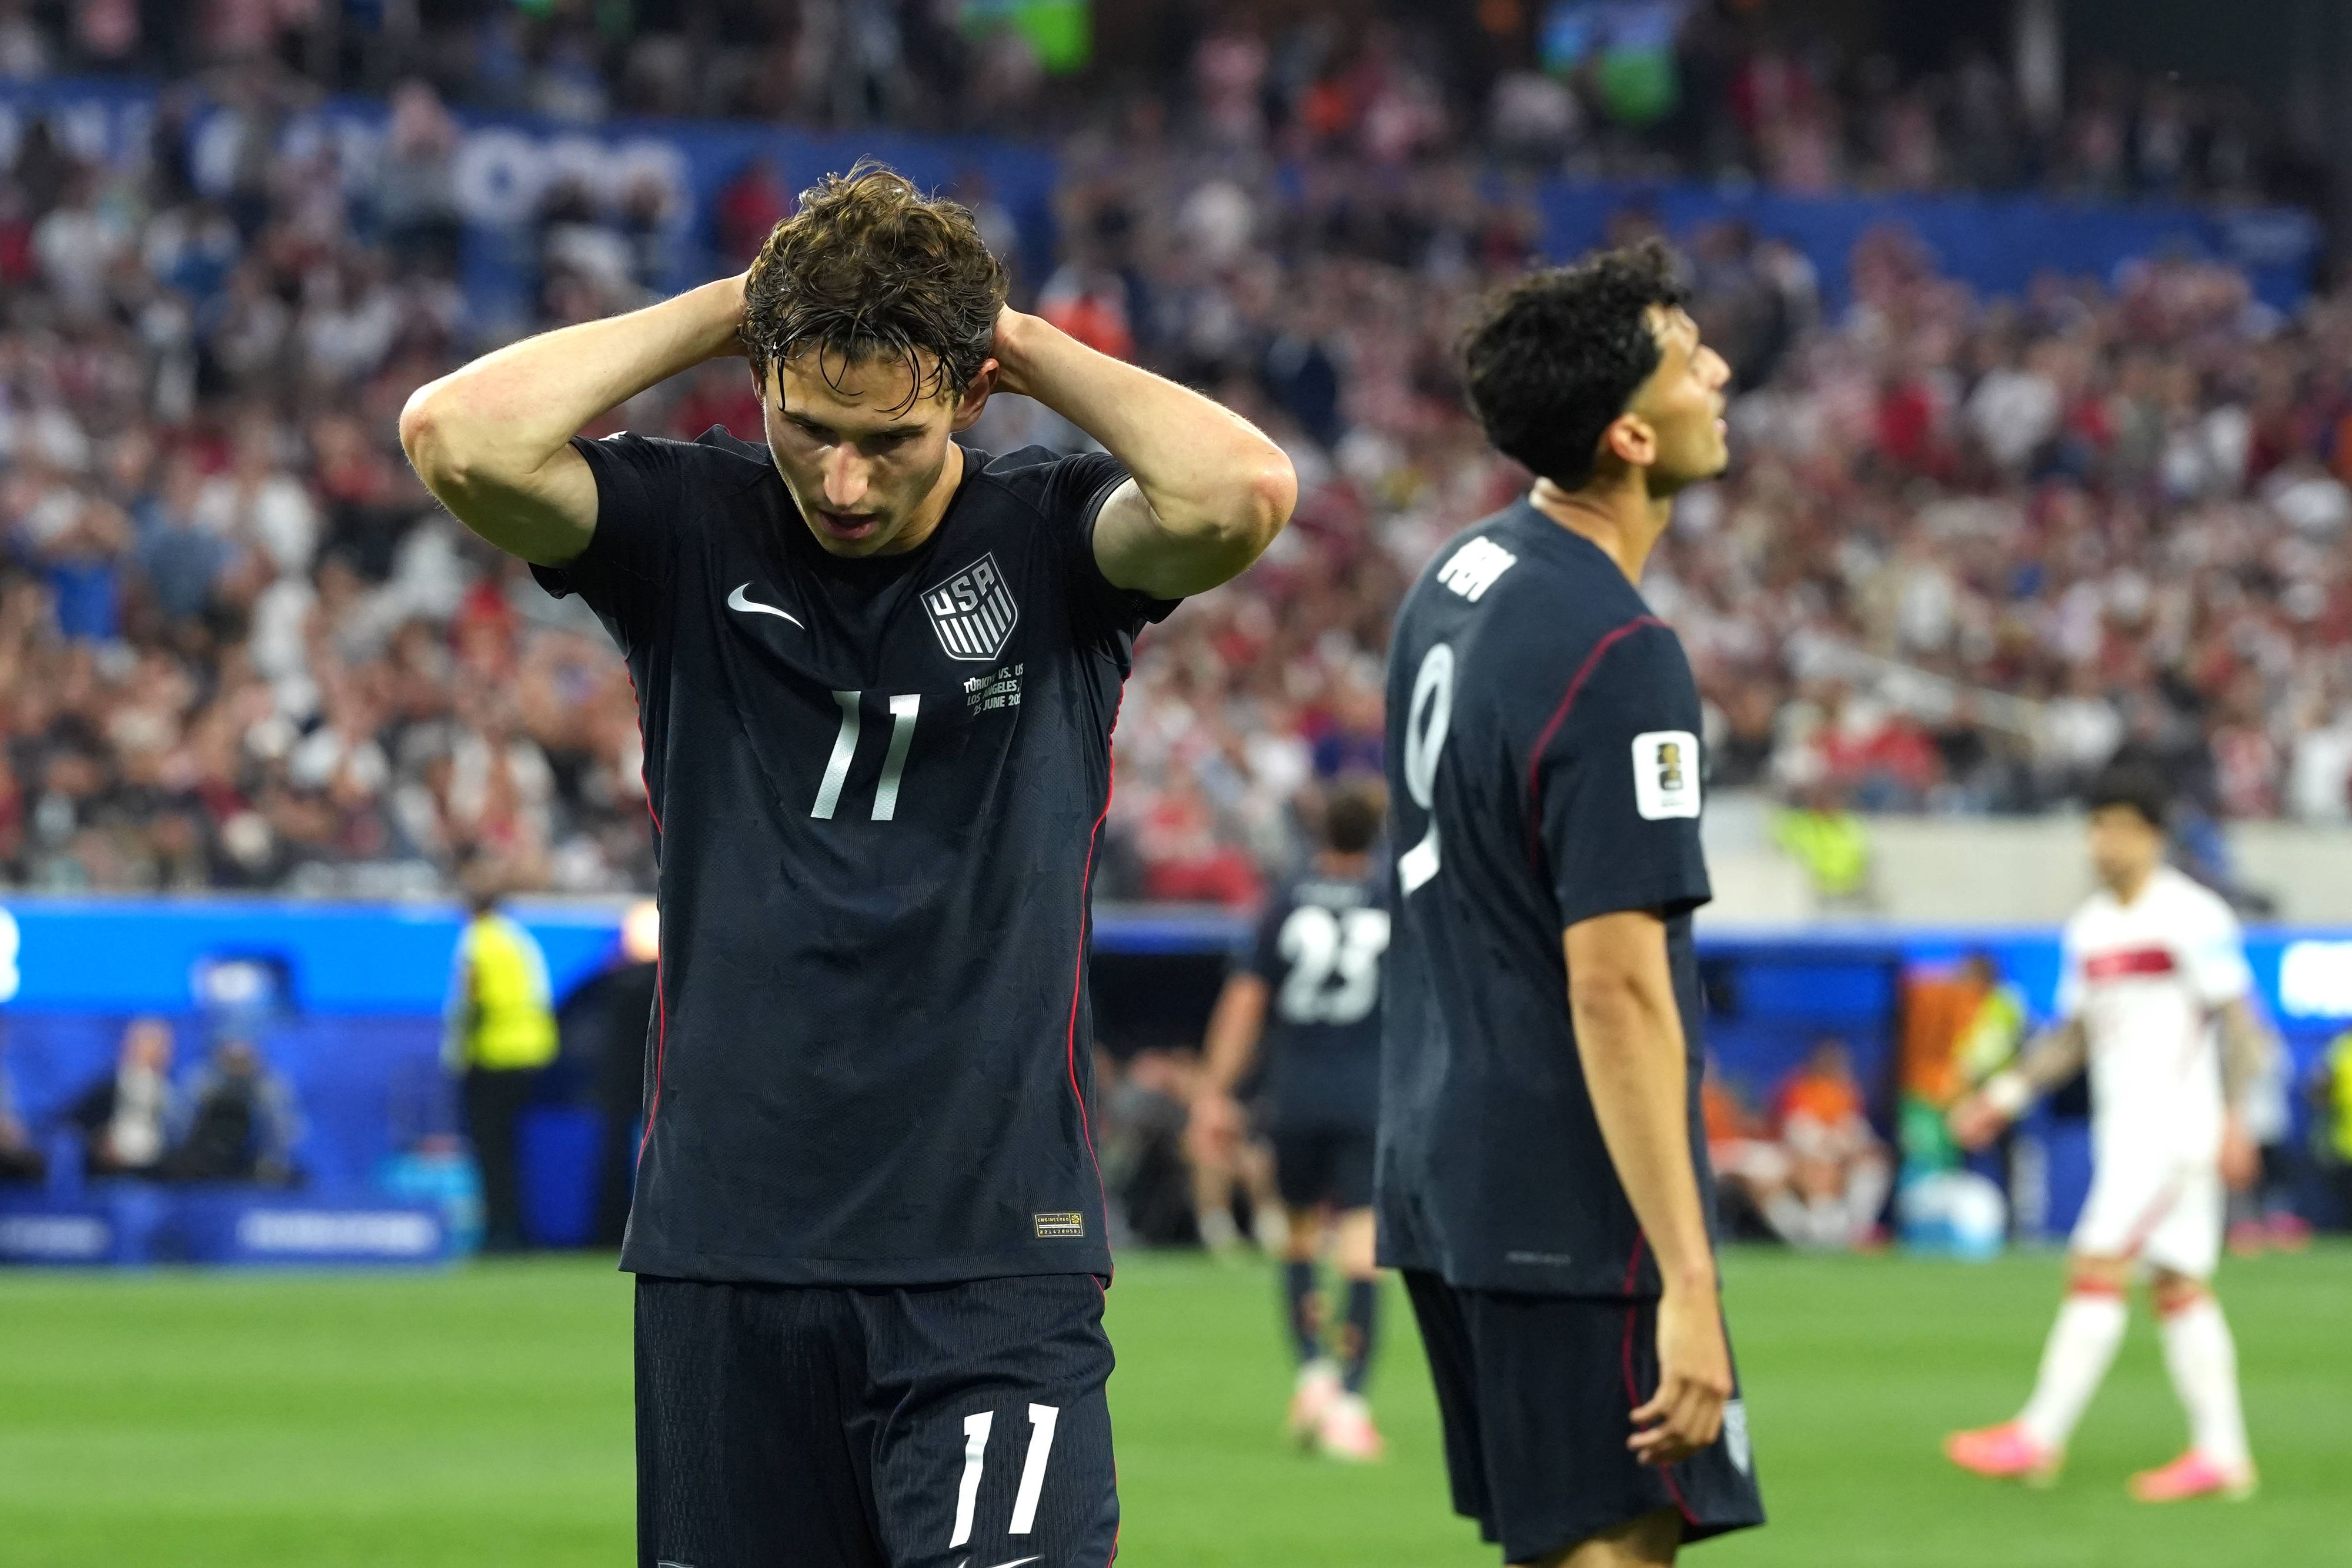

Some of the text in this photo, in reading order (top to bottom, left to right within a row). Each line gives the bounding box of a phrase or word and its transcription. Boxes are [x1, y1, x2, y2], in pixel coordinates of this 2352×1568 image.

[928, 561, 995, 616] USA
[998, 667, 1011, 679] VS.
[1015, 663, 1023, 676] US
[967, 693, 981, 706] LOS
[983, 696, 1005, 711] JUNE
[810, 690, 921, 821] 11
[1398, 643, 1454, 897] 9
[949, 1403, 1058, 1549] 11
